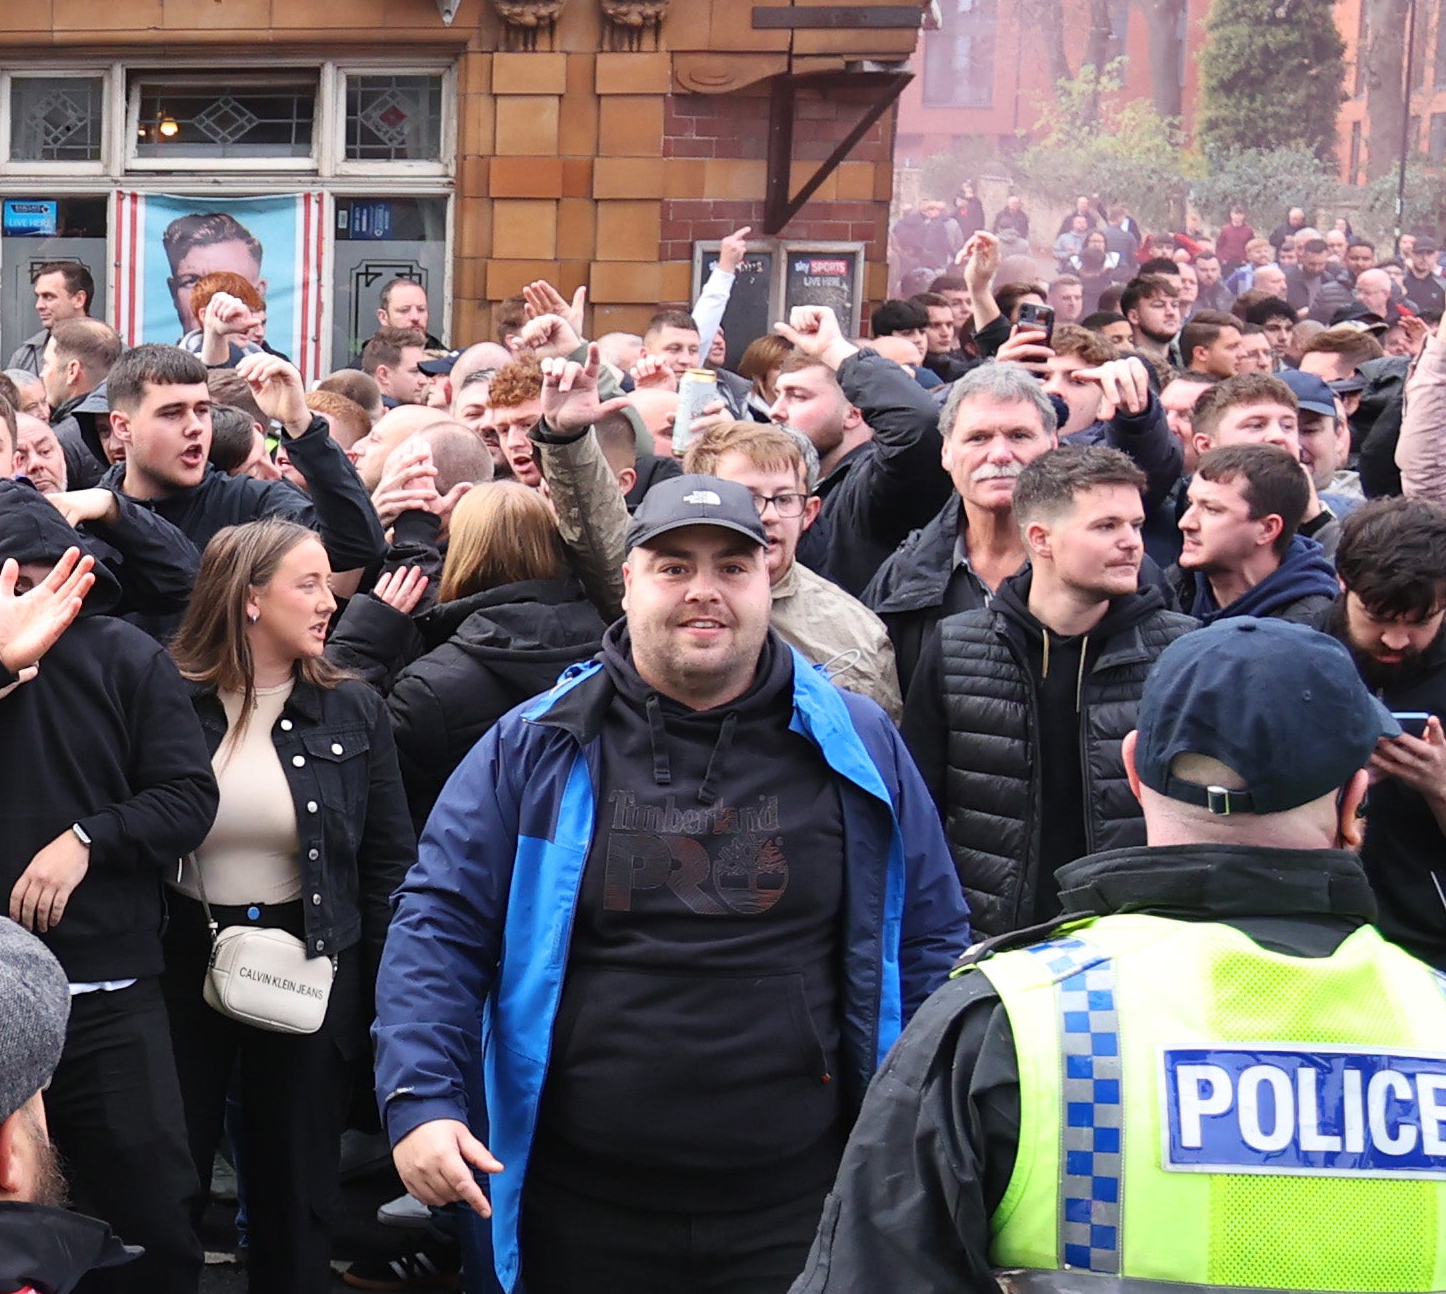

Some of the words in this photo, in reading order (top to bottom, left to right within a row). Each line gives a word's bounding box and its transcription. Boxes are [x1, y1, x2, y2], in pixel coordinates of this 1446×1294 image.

[239, 966, 271, 985] CALVIN
[272, 977, 297, 993] KLEIN
[296, 983, 323, 1001] JEANS
